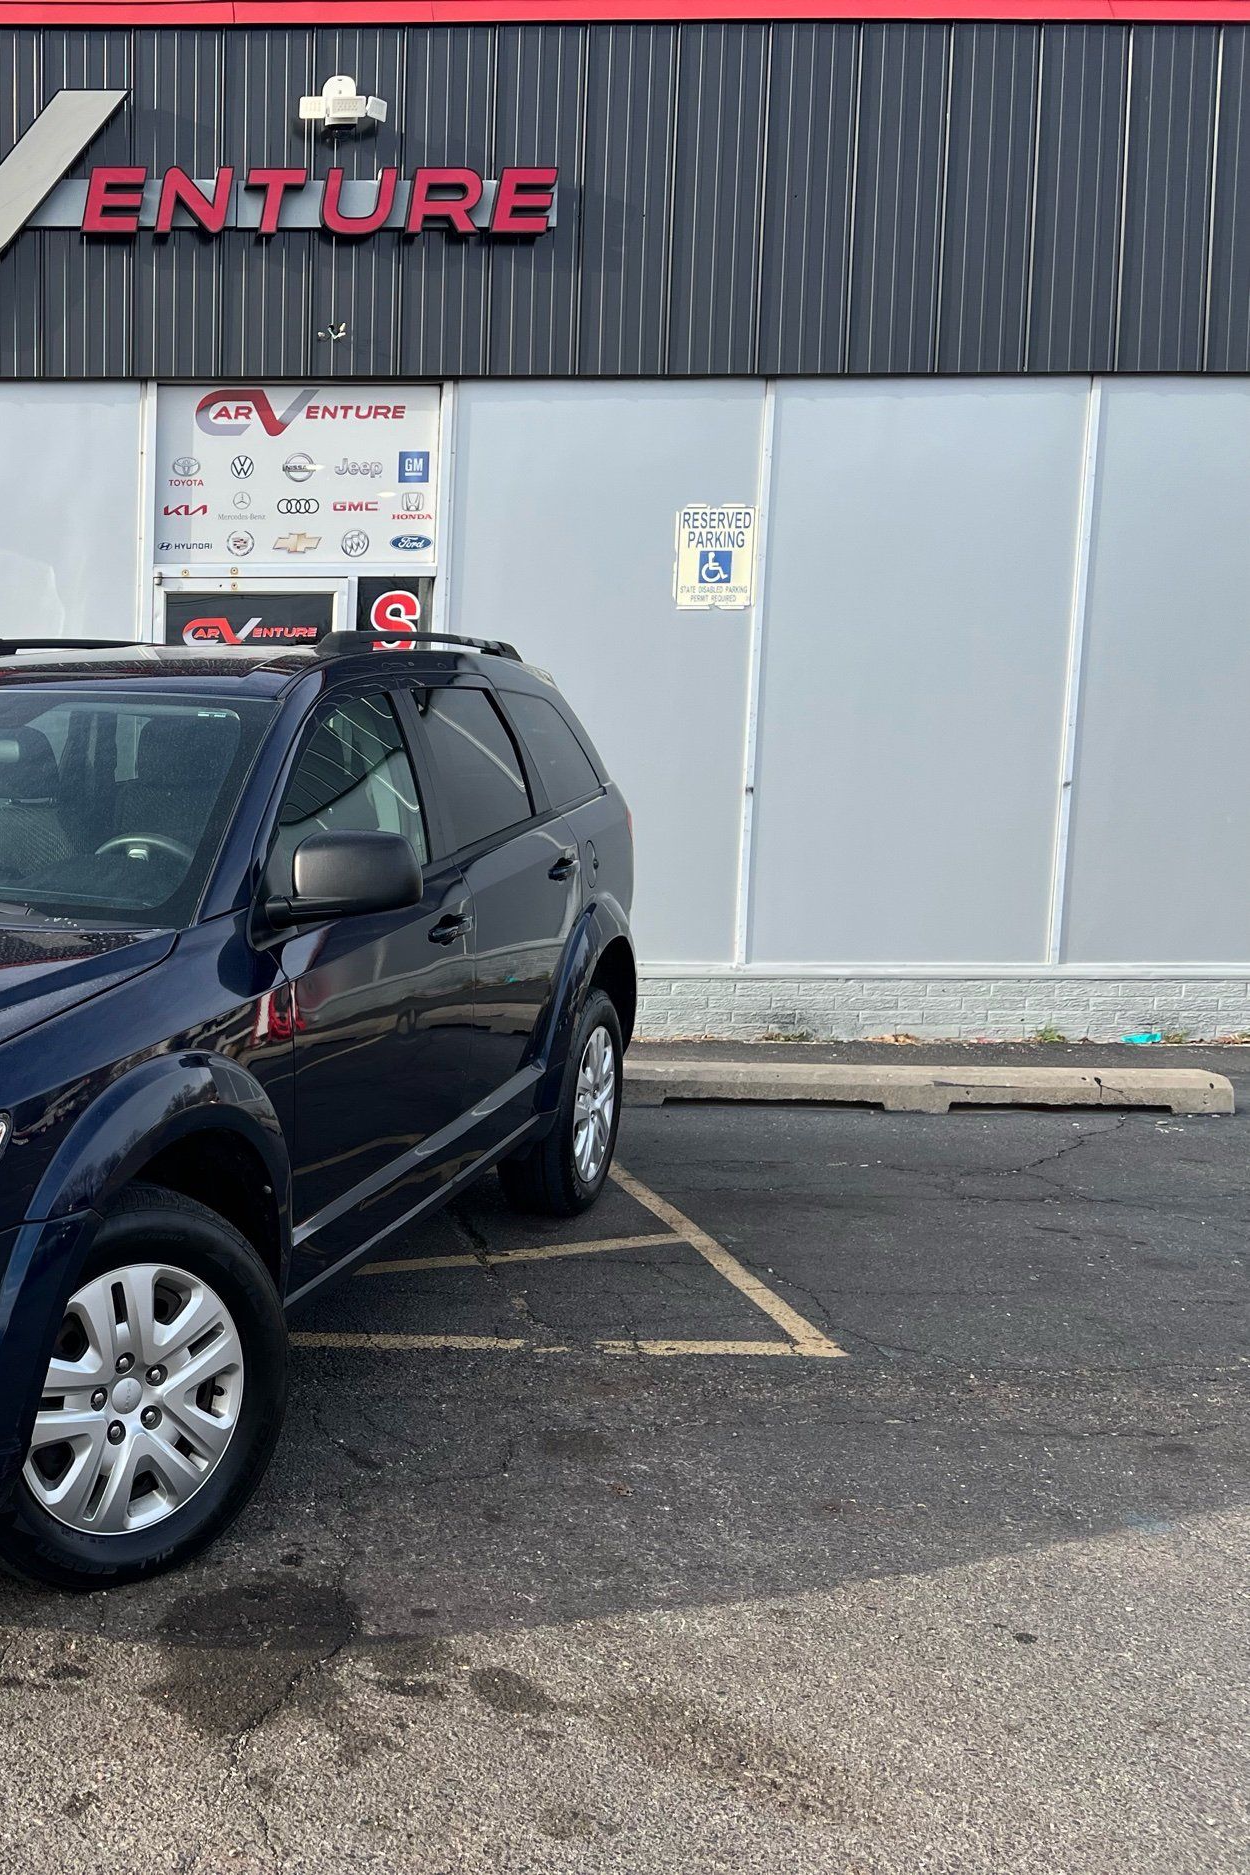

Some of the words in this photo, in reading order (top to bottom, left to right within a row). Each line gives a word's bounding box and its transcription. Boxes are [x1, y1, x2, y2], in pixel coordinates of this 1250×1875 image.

[334, 457, 382, 478] Jeep
[404, 458, 423, 472] GM
[168, 479, 204, 487] TOYOTA
[333, 501, 379, 511] GMC
[682, 511, 752, 529] RESERVED
[398, 536, 425, 548] Ford
[687, 530, 745, 548] PARKING
